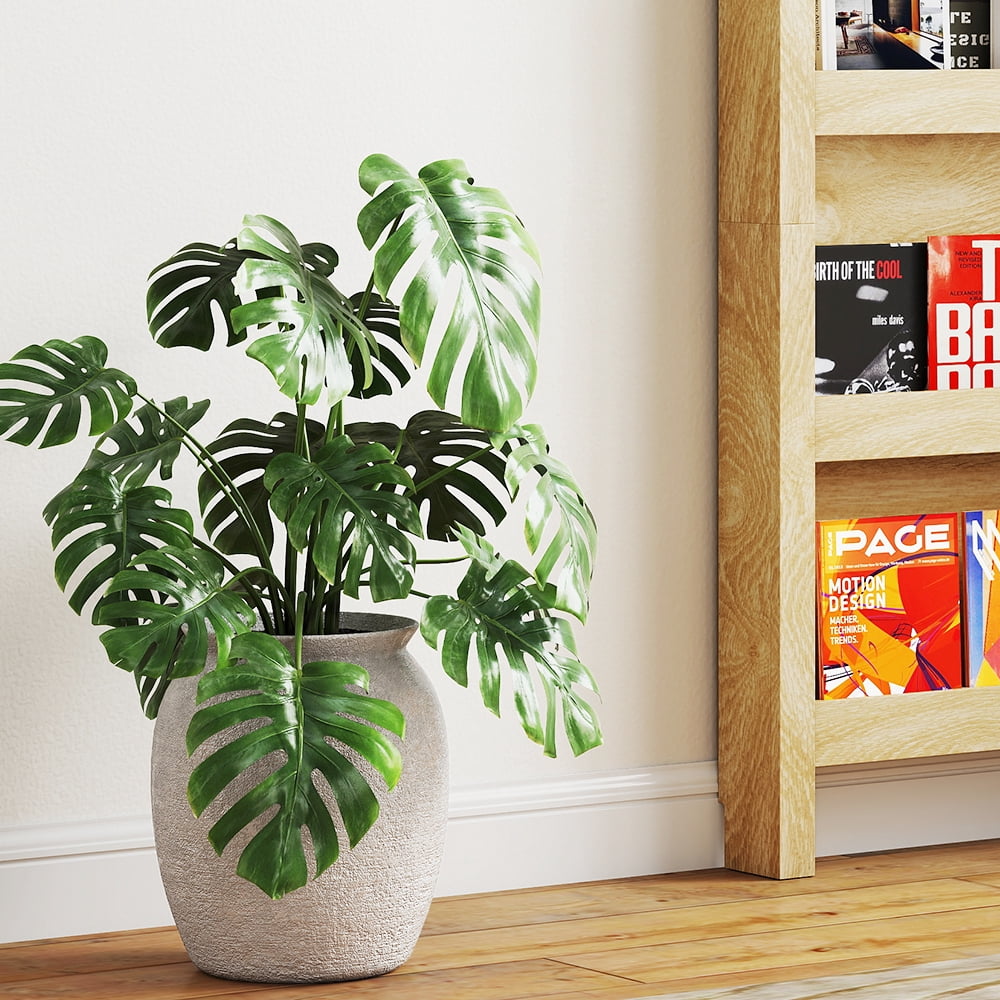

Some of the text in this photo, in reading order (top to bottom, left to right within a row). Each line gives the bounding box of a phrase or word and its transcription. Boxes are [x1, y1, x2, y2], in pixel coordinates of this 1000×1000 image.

[815, 260, 903, 281] IRTH OF THE COOL
[872, 314, 904, 326] miles davis
[835, 524, 950, 558] PAGE
[828, 575, 886, 595] MOTION
[828, 591, 887, 613] DESIGN
